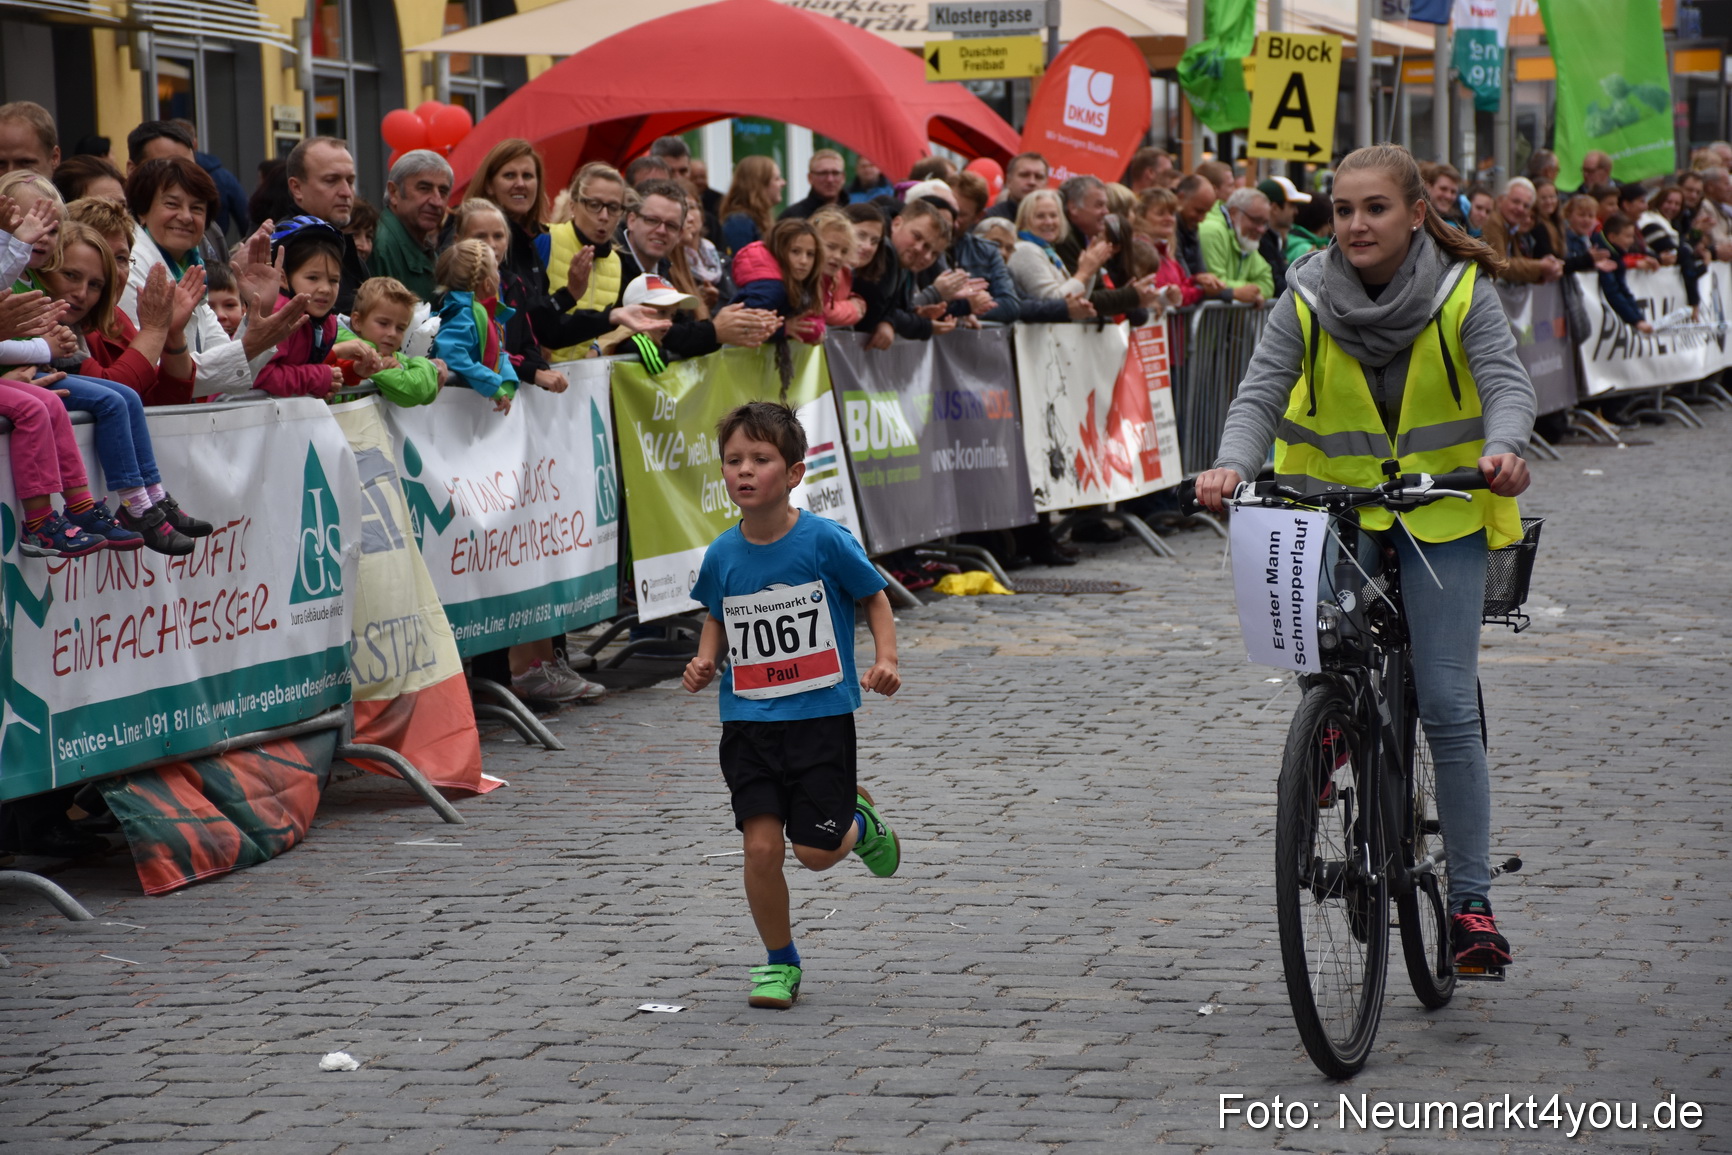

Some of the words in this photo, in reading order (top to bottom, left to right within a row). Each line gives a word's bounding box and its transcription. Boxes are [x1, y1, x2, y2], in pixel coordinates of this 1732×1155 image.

[935, 7, 1033, 28] Klostergasse
[959, 46, 1008, 58] Duschen
[1269, 36, 1332, 63] Block
[963, 59, 1005, 71] Freibad
[1068, 104, 1104, 128] DKMS
[1268, 71, 1315, 133] A
[652, 390, 677, 421] Der
[1266, 531, 1281, 585] Mann
[1290, 518, 1309, 665] Schnupperlauf
[725, 606, 752, 617] PARTL
[754, 596, 807, 614] Neumarkt
[1270, 591, 1285, 650] Erster
[734, 608, 819, 660] 7067
[767, 663, 800, 682] Paul
[58, 722, 143, 761] Service-Line:
